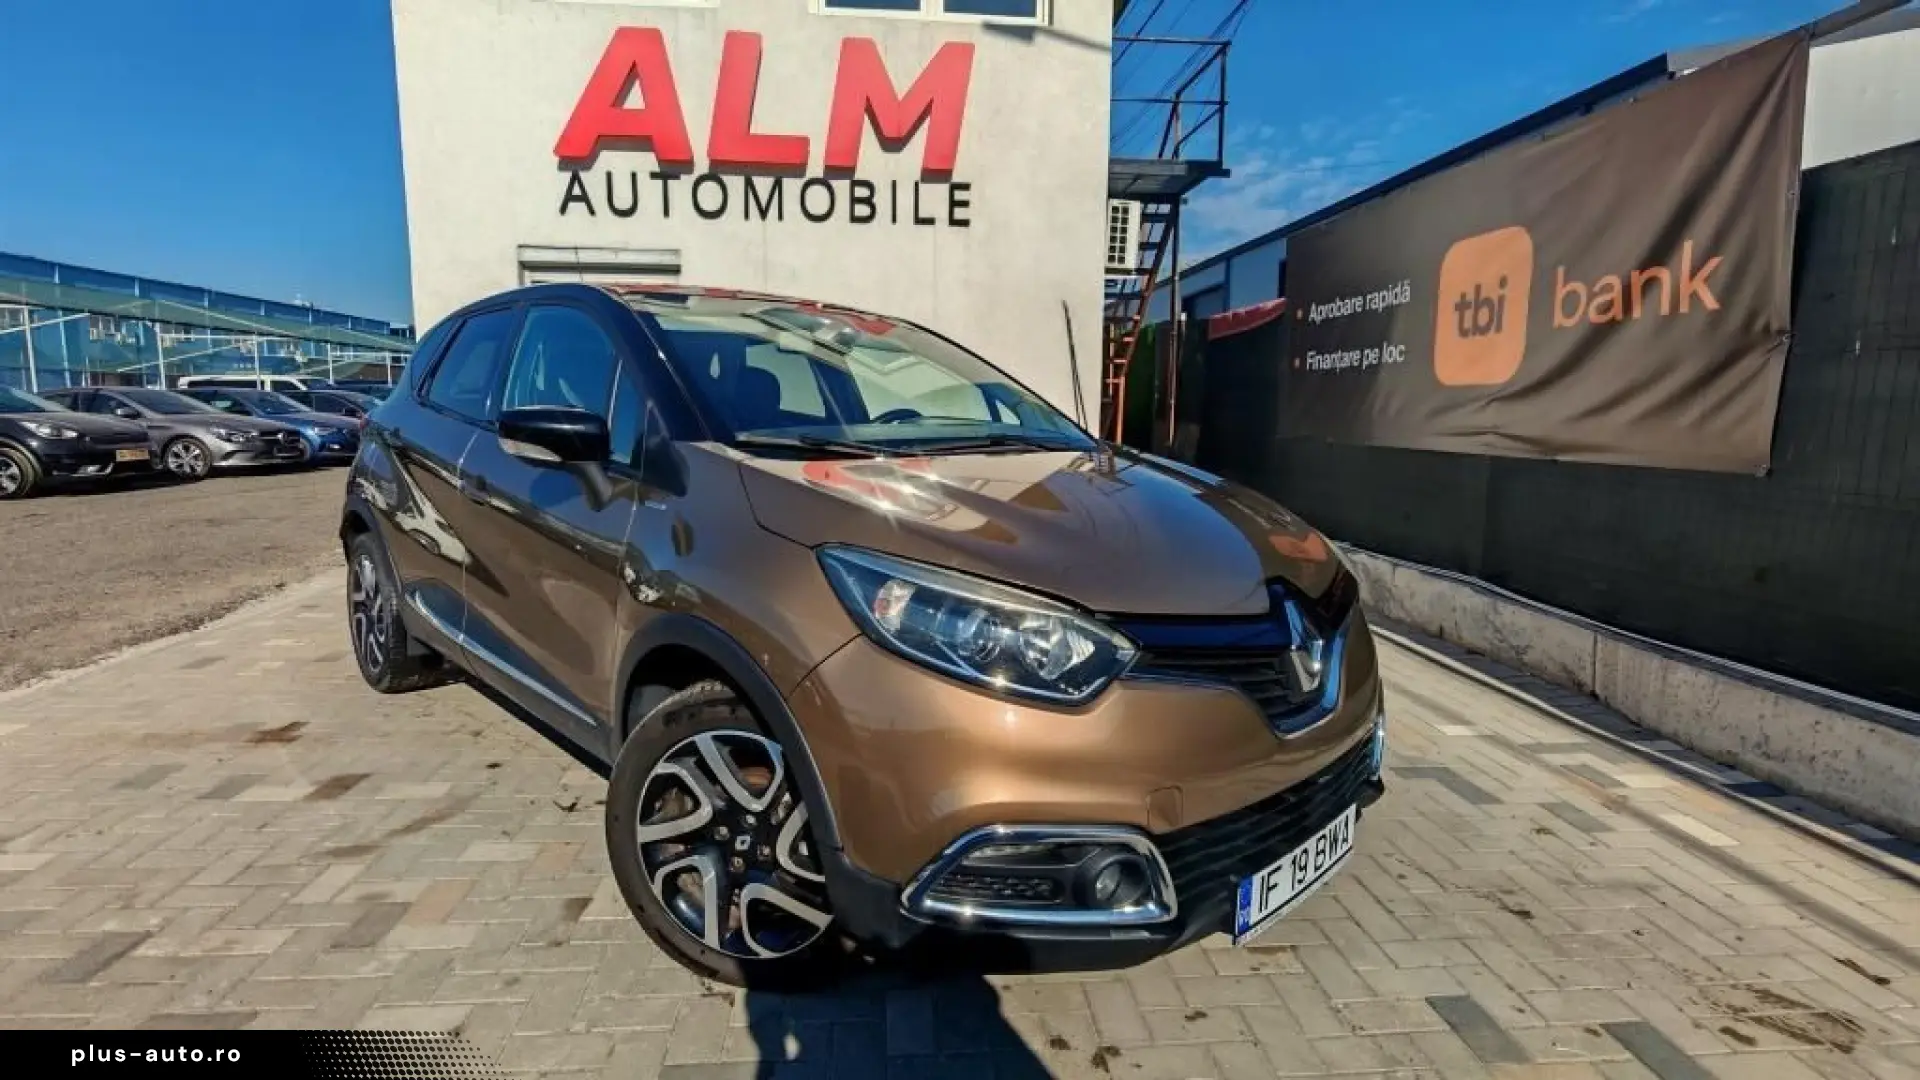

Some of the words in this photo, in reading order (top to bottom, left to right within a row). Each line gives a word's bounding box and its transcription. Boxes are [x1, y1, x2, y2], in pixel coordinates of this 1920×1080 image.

[553, 26, 976, 182] ALM
[559, 171, 971, 228] AUTOMOBILE
[1308, 295, 1363, 325] Aprobare
[1365, 279, 1411, 313] rapidă
[1455, 276, 1508, 338] tbi
[1552, 239, 1724, 329] bank
[1362, 348, 1379, 370] pe
[1381, 341, 1406, 364] loc
[1258, 864, 1283, 913] IF
[1290, 847, 1309, 892] 19
[1314, 815, 1349, 873] BWA
